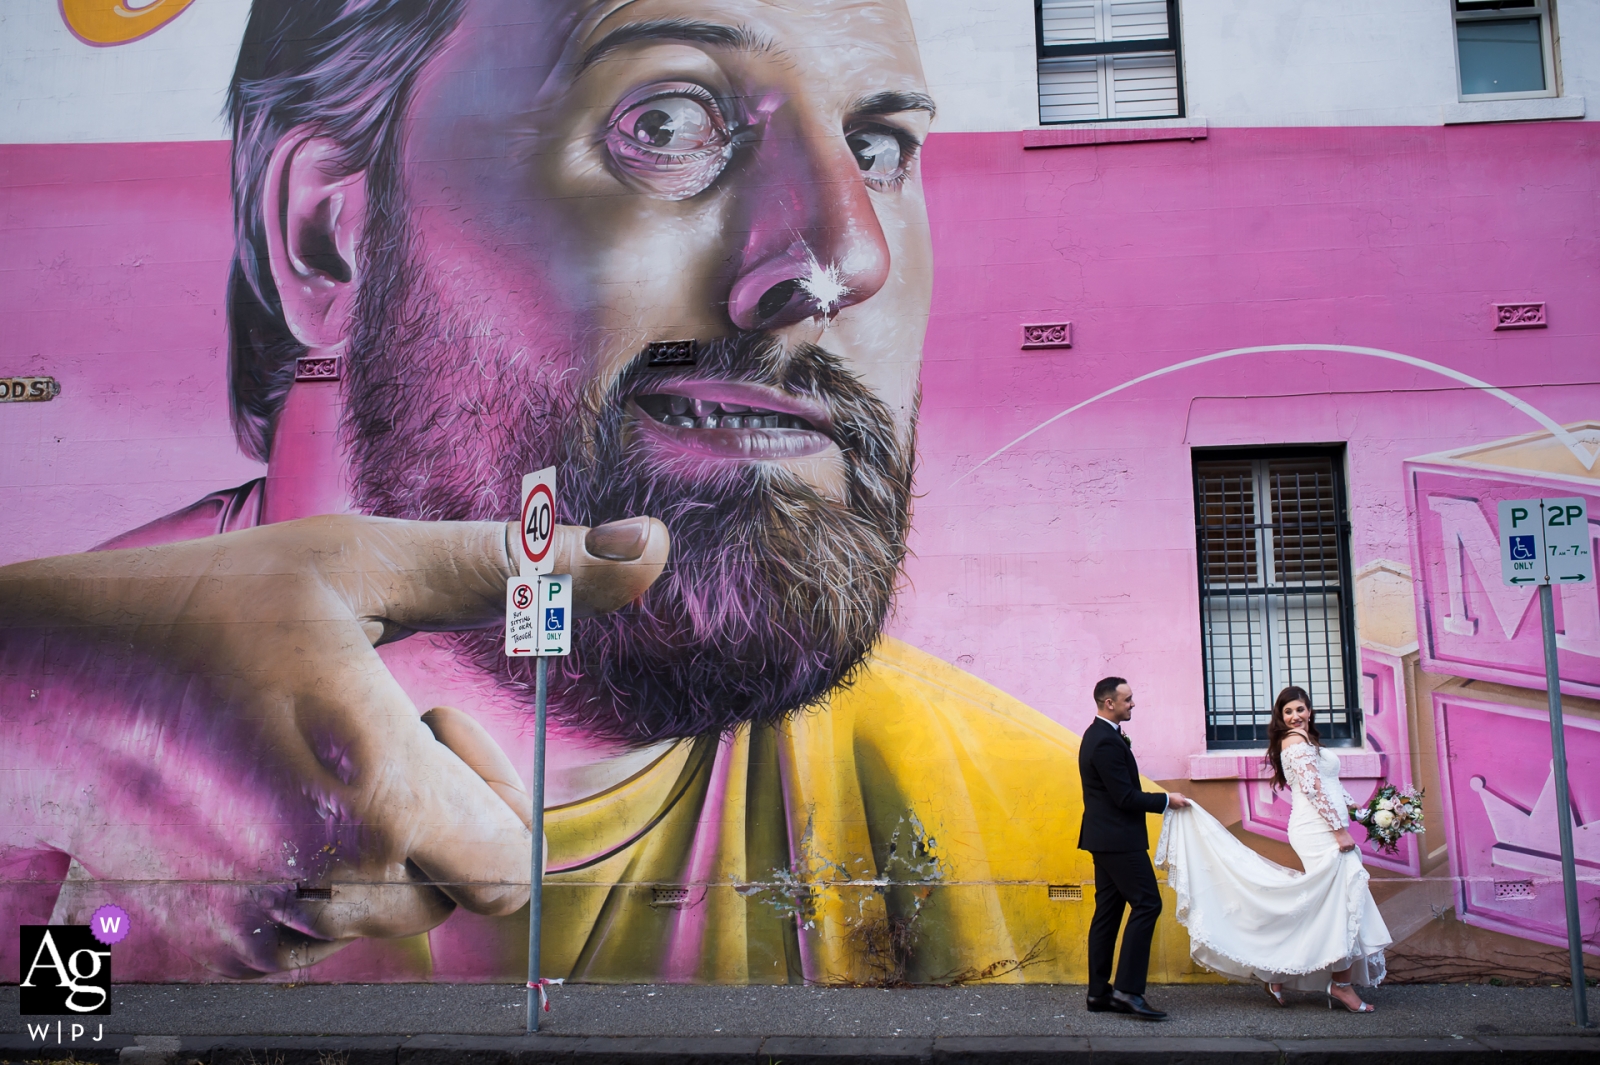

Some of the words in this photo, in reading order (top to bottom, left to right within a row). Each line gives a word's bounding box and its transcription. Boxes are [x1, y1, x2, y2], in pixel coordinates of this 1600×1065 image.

[526, 503, 550, 542] 40
[1511, 508, 1528, 528] P
[1547, 505, 1583, 526] 2P
[1514, 562, 1533, 570] ONLY
[517, 588, 529, 605] S
[549, 582, 562, 601] P
[510, 615, 531, 626] SITTING
